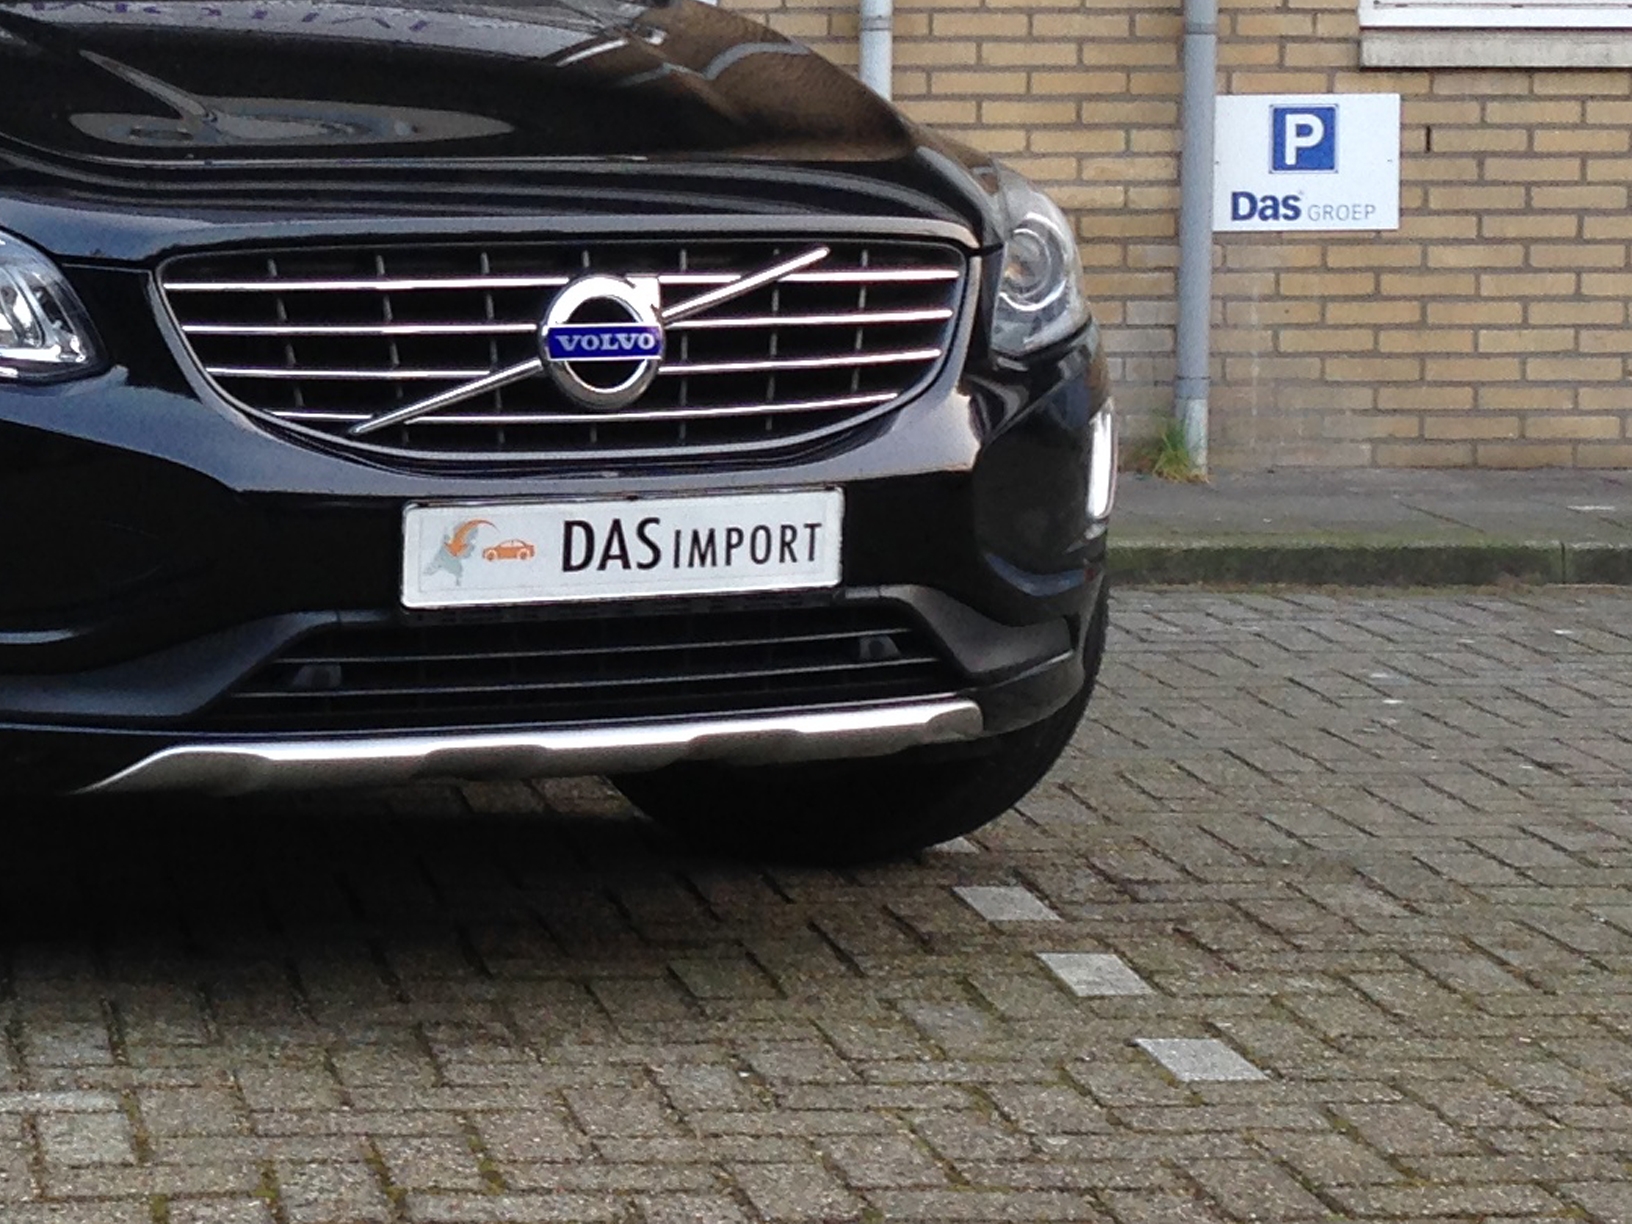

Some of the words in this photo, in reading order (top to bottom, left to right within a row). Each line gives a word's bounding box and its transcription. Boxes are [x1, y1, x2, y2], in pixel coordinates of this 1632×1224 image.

[1284, 113, 1324, 166] P
[1230, 191, 1302, 222] Das
[1307, 203, 1377, 222] GROEP
[555, 332, 656, 351] VOLVO
[562, 517, 662, 573] DAS
[673, 522, 823, 569] IMPORT
